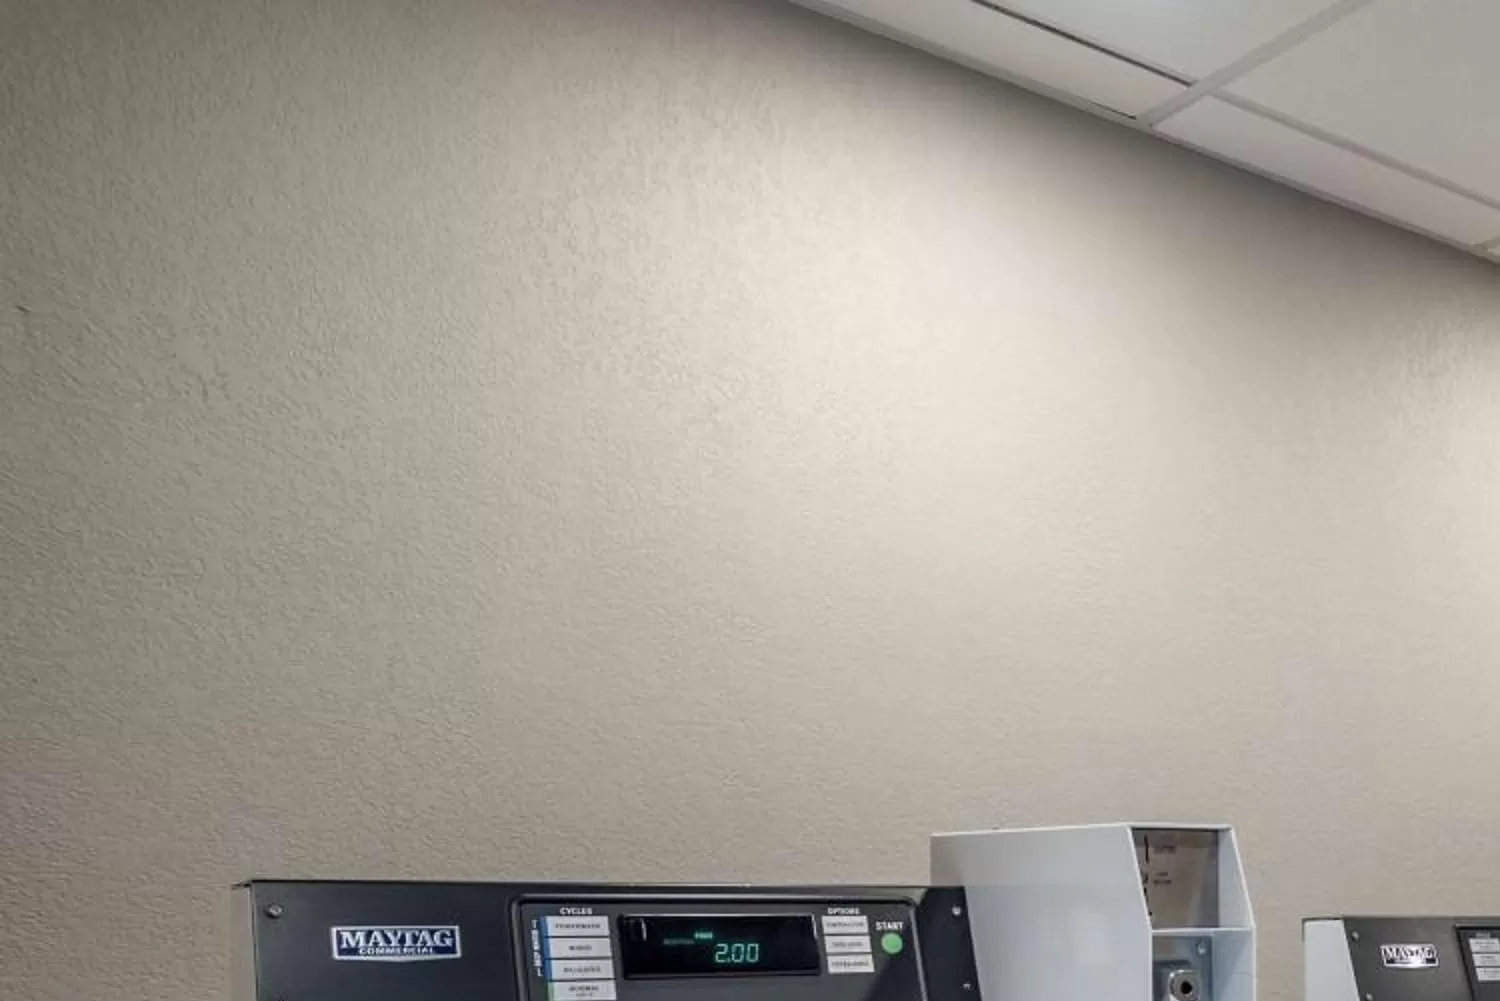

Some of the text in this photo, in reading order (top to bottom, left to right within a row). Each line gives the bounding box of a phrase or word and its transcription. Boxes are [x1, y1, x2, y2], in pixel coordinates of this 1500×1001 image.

[560, 907, 593, 915] CYCLES
[875, 921, 904, 931] START
[340, 930, 453, 948] MAYTAG
[714, 943, 760, 963] 2.00
